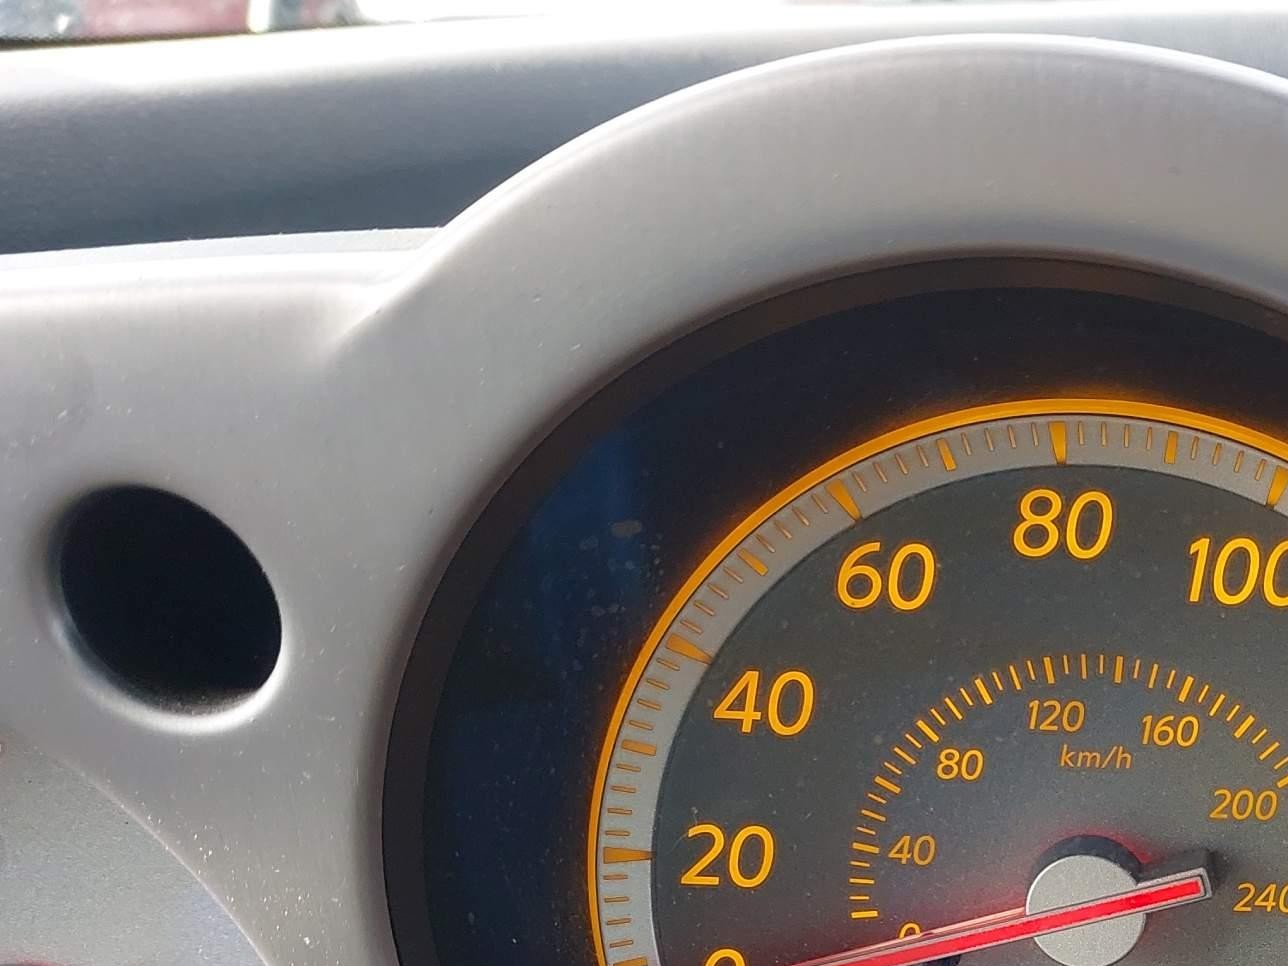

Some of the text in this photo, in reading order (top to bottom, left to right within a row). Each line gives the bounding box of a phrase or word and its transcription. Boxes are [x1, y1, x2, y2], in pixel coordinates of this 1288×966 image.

[1013, 488, 1113, 560] 80
[837, 541, 935, 611] 60
[713, 670, 814, 736] 40
[1028, 699, 1085, 733] 120
[1142, 714, 1200, 748] 160
[936, 748, 984, 781] 80
[1060, 747, 1132, 768] km/h
[1208, 789, 1279, 822] 200
[680, 823, 775, 888] 20
[887, 835, 936, 866] 40
